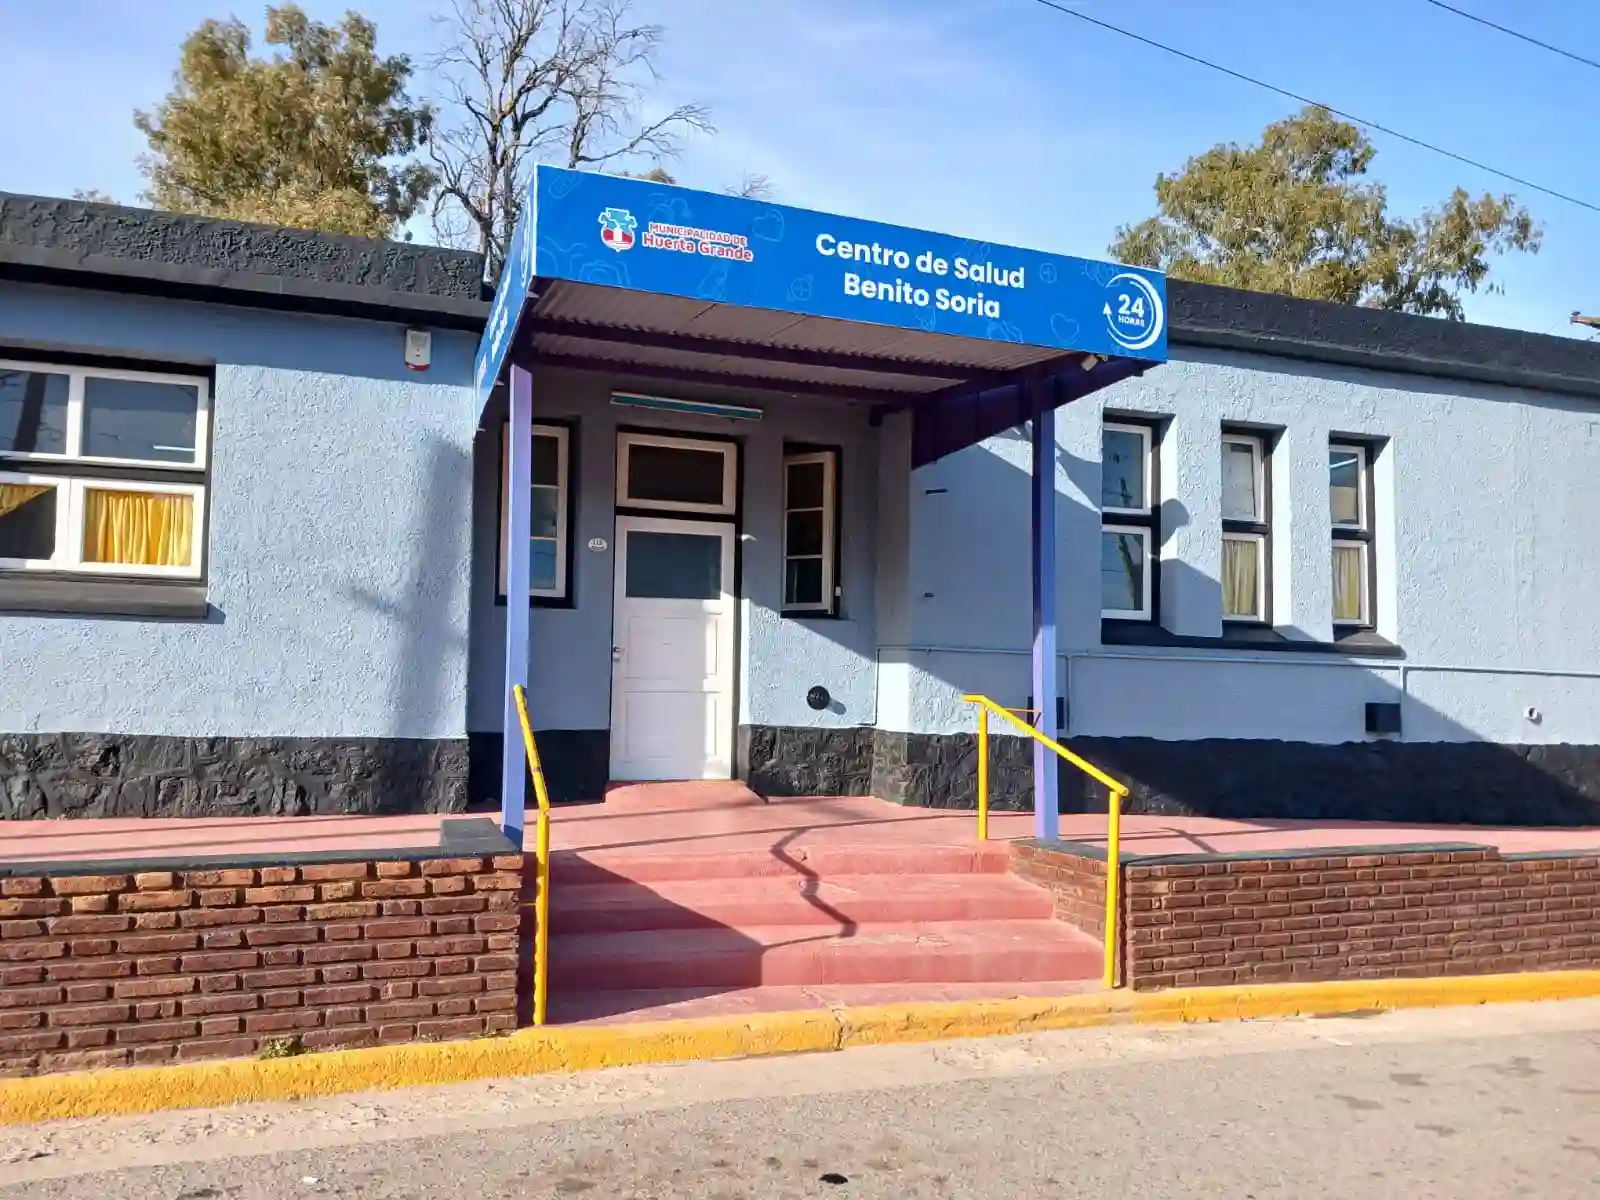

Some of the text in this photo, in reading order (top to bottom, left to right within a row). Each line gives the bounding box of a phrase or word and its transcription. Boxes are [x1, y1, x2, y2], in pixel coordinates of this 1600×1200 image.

[643, 232, 753, 262] Huerta Grande
[650, 223, 746, 246] MUNICIPALIDAD DE
[815, 234, 1025, 289] Centro de Salud
[844, 273, 1000, 318] Benito Soria
[1118, 294, 1144, 317] 24
